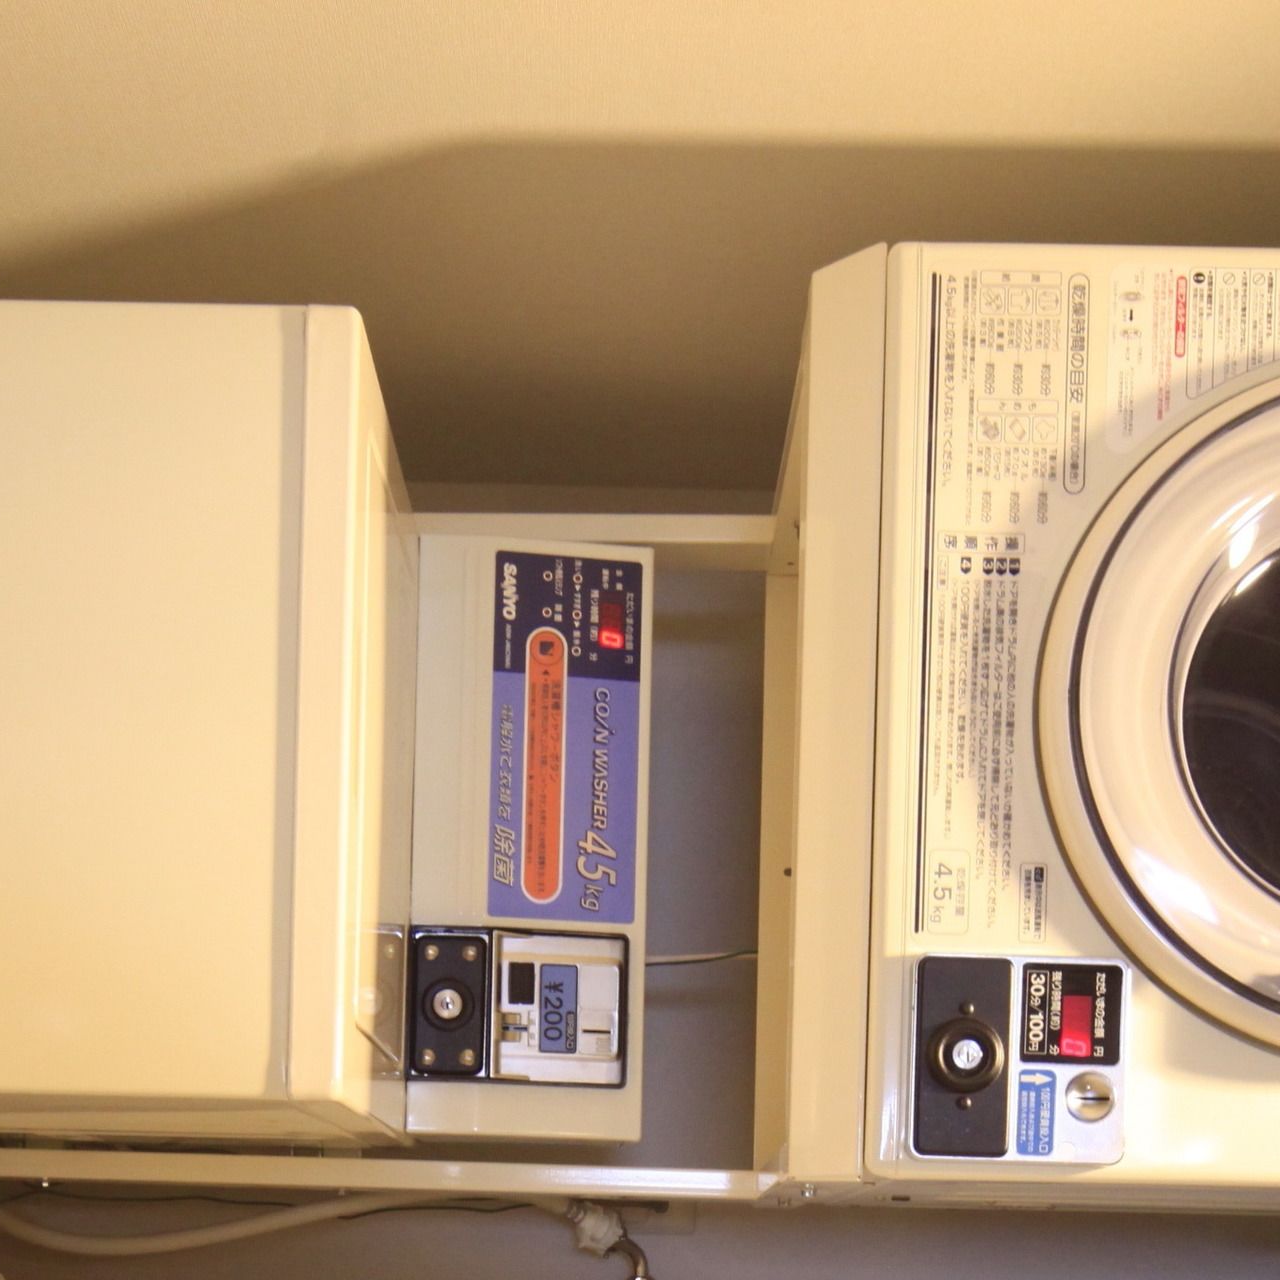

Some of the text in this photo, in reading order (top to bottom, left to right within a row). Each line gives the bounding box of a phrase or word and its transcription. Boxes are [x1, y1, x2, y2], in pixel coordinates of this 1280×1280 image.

[1069, 285, 1086, 403] 乾燥時間の目安
[500, 562, 518, 620] SANYO
[600, 631, 624, 649] 0
[591, 749, 609, 830] WASHER
[576, 830, 617, 885] 4.5
[578, 884, 603, 911] kg
[930, 862, 954, 924] 4.5 kg
[543, 982, 564, 1041] ¥200
[1049, 1045, 1059, 1056] 分
[1062, 1039, 1087, 1056] 0
[1093, 1046, 1104, 1057] 円
